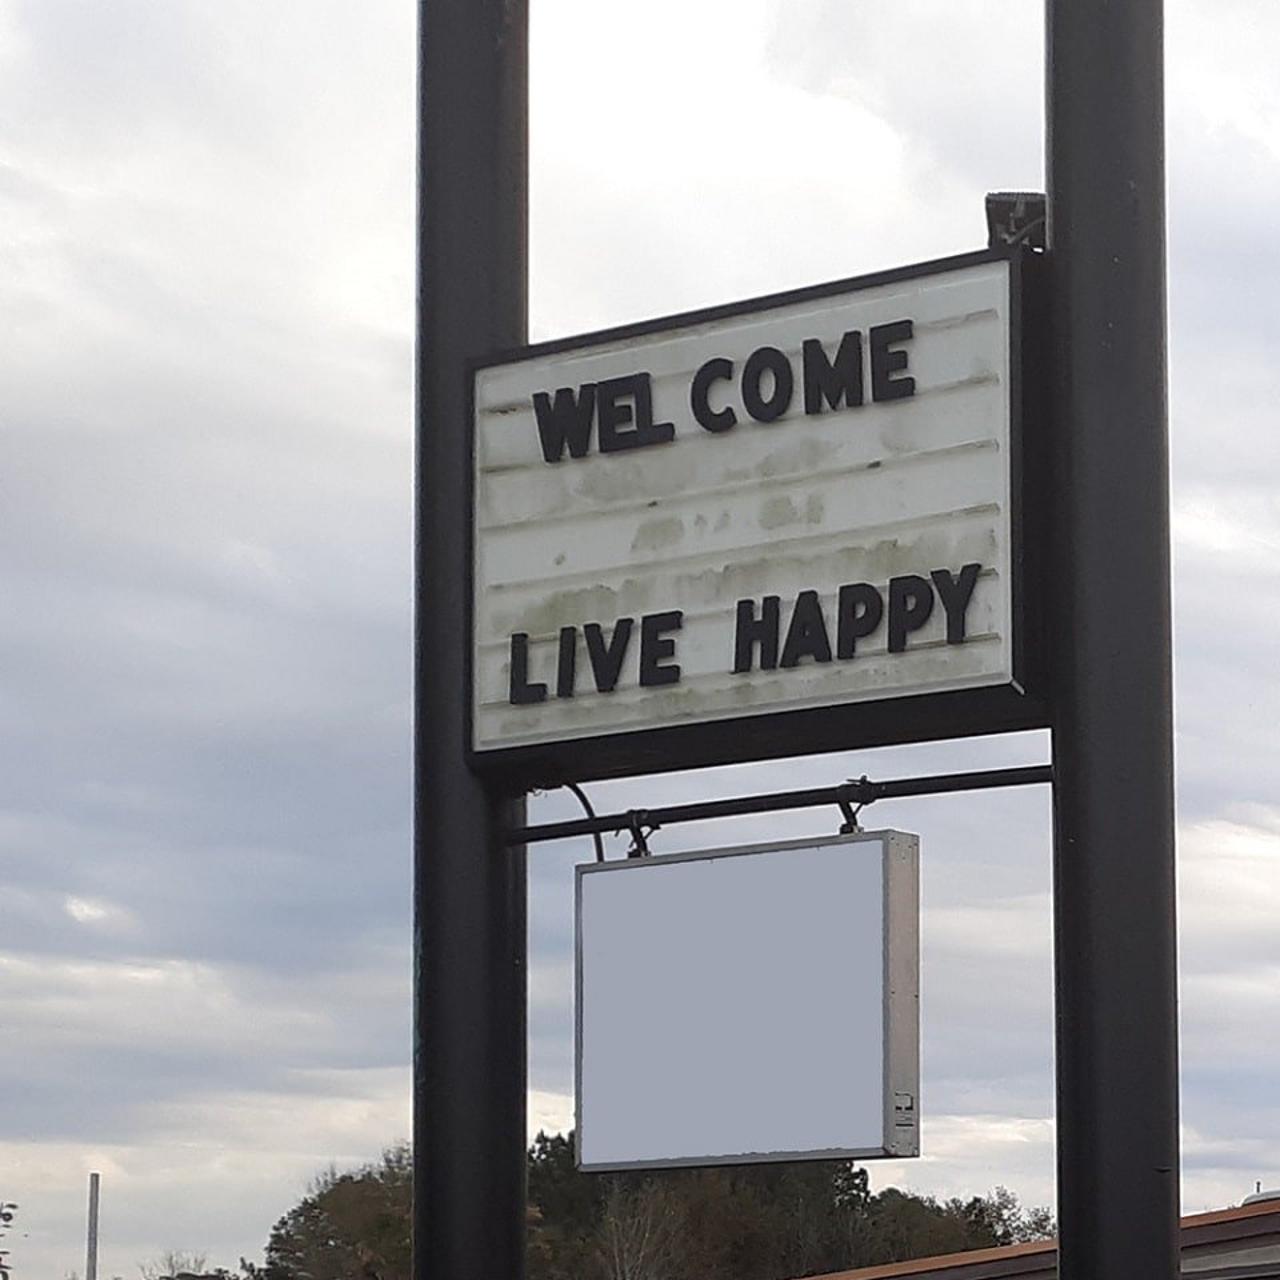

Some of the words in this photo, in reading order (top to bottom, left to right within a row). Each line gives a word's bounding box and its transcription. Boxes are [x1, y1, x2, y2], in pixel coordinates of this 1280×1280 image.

[532, 319, 916, 463] WELCOME
[510, 610, 683, 705] LIVE
[733, 563, 982, 674] HAPPY
